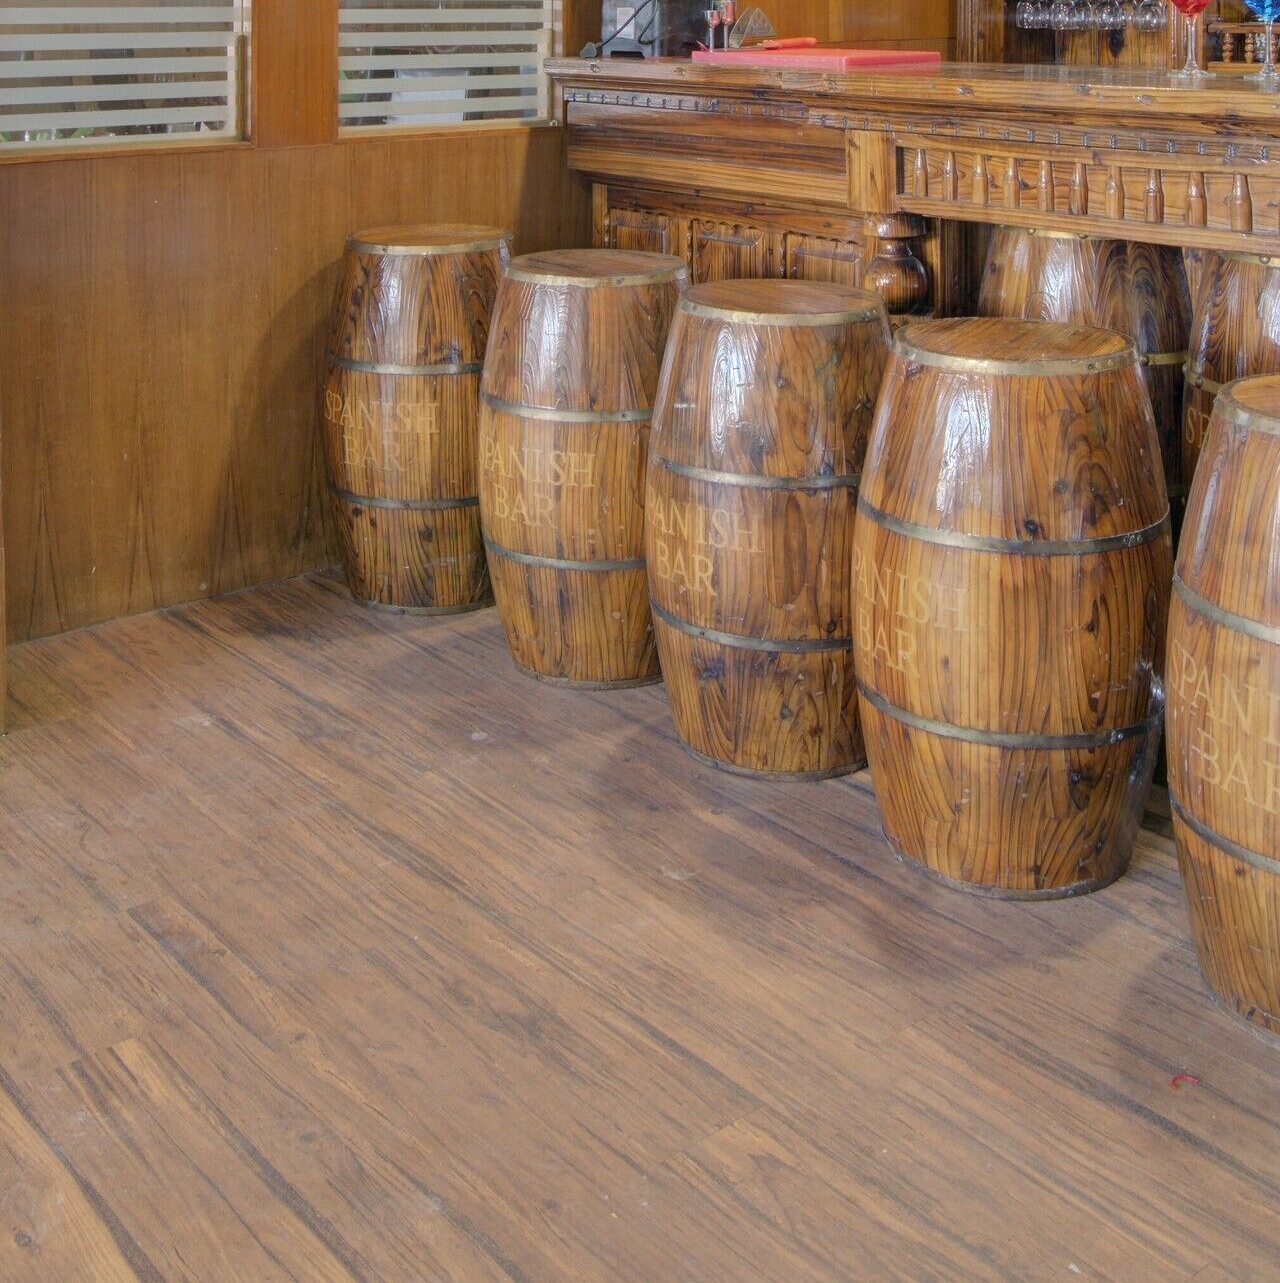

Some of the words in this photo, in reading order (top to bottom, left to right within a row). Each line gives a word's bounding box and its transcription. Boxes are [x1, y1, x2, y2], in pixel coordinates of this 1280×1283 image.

[325, 389, 440, 434] SPANISH
[343, 434, 406, 472] BAR
[492, 482, 558, 529] BAR
[646, 483, 765, 554] PANISH
[655, 538, 718, 597] BAR
[851, 543, 969, 633] PANISH
[857, 605, 920, 678] BAR
